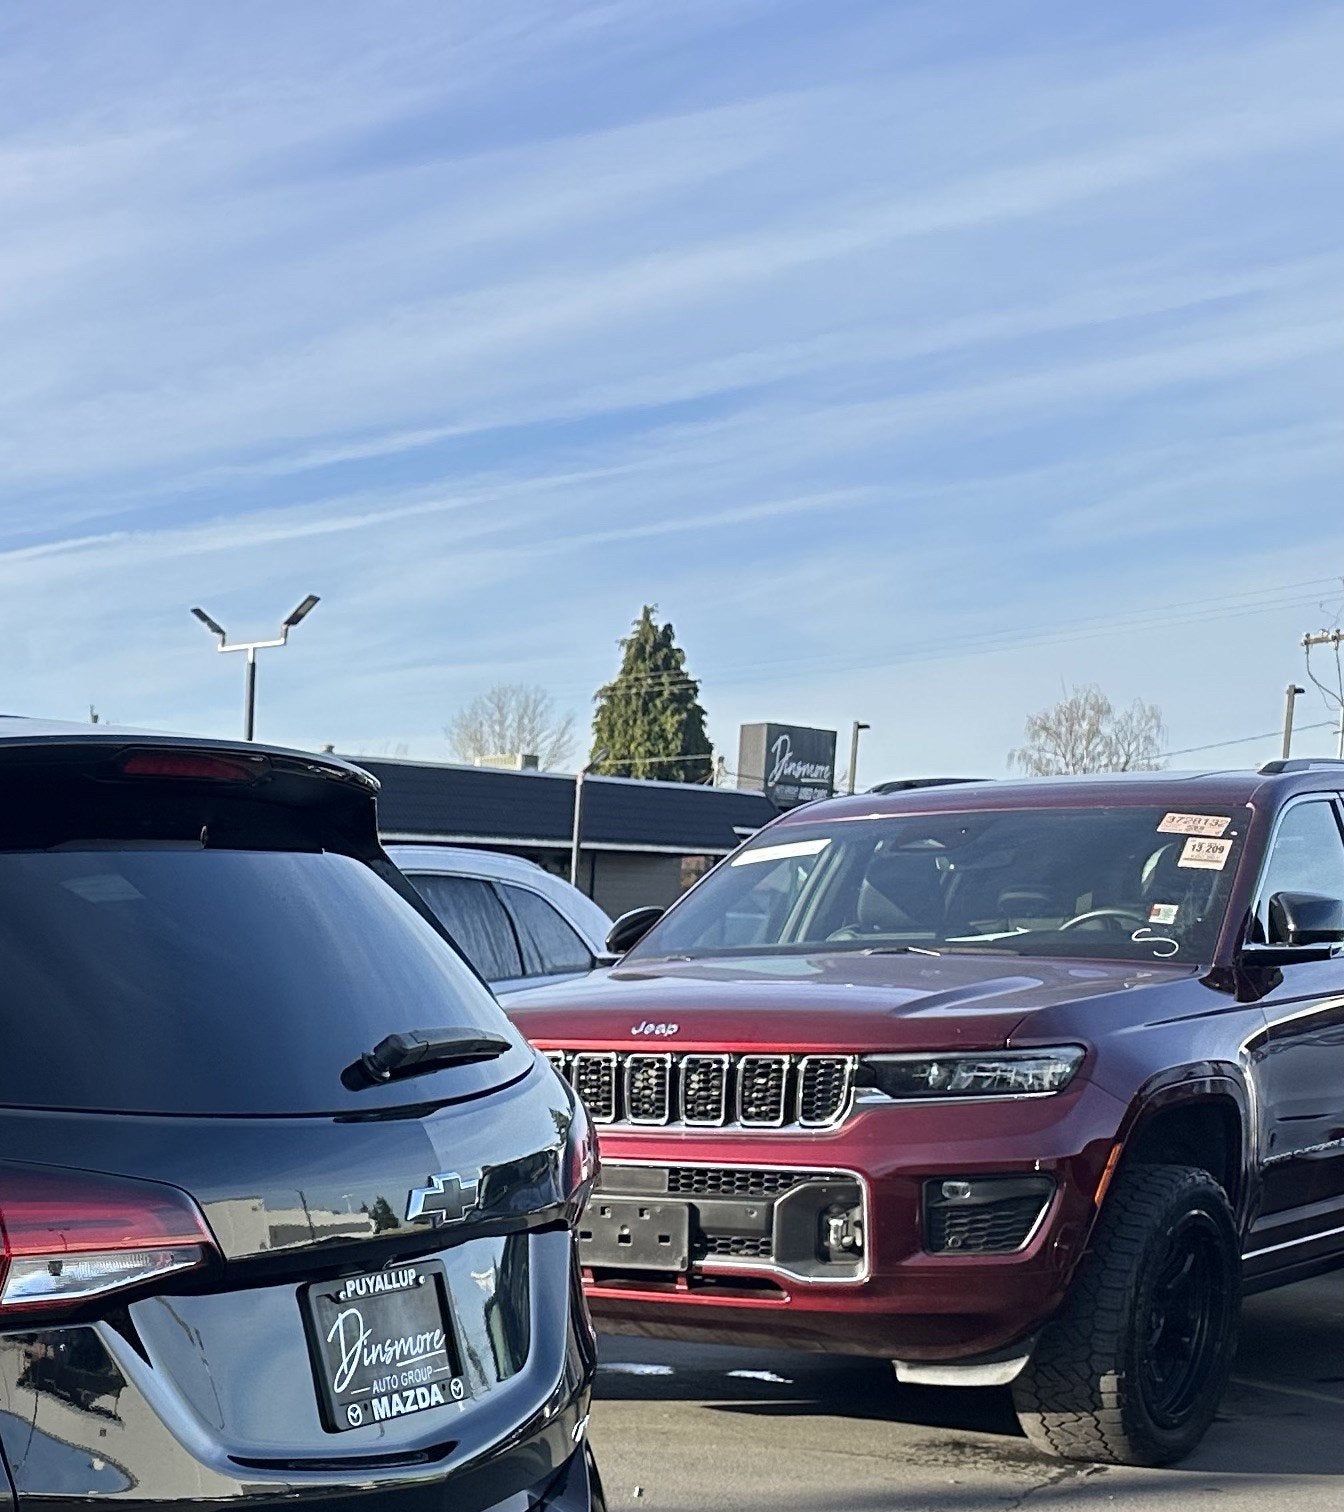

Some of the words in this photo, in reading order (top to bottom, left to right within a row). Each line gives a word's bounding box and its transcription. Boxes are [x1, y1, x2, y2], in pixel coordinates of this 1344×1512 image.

[631, 1021, 679, 1037] Jeep
[345, 1269, 416, 1298] PUYALLUP
[326, 1308, 445, 1394] Dinsmore
[372, 1374, 398, 1394] AUTO
[400, 1365, 433, 1387] GROUP
[372, 1384, 444, 1420] MAZDA
